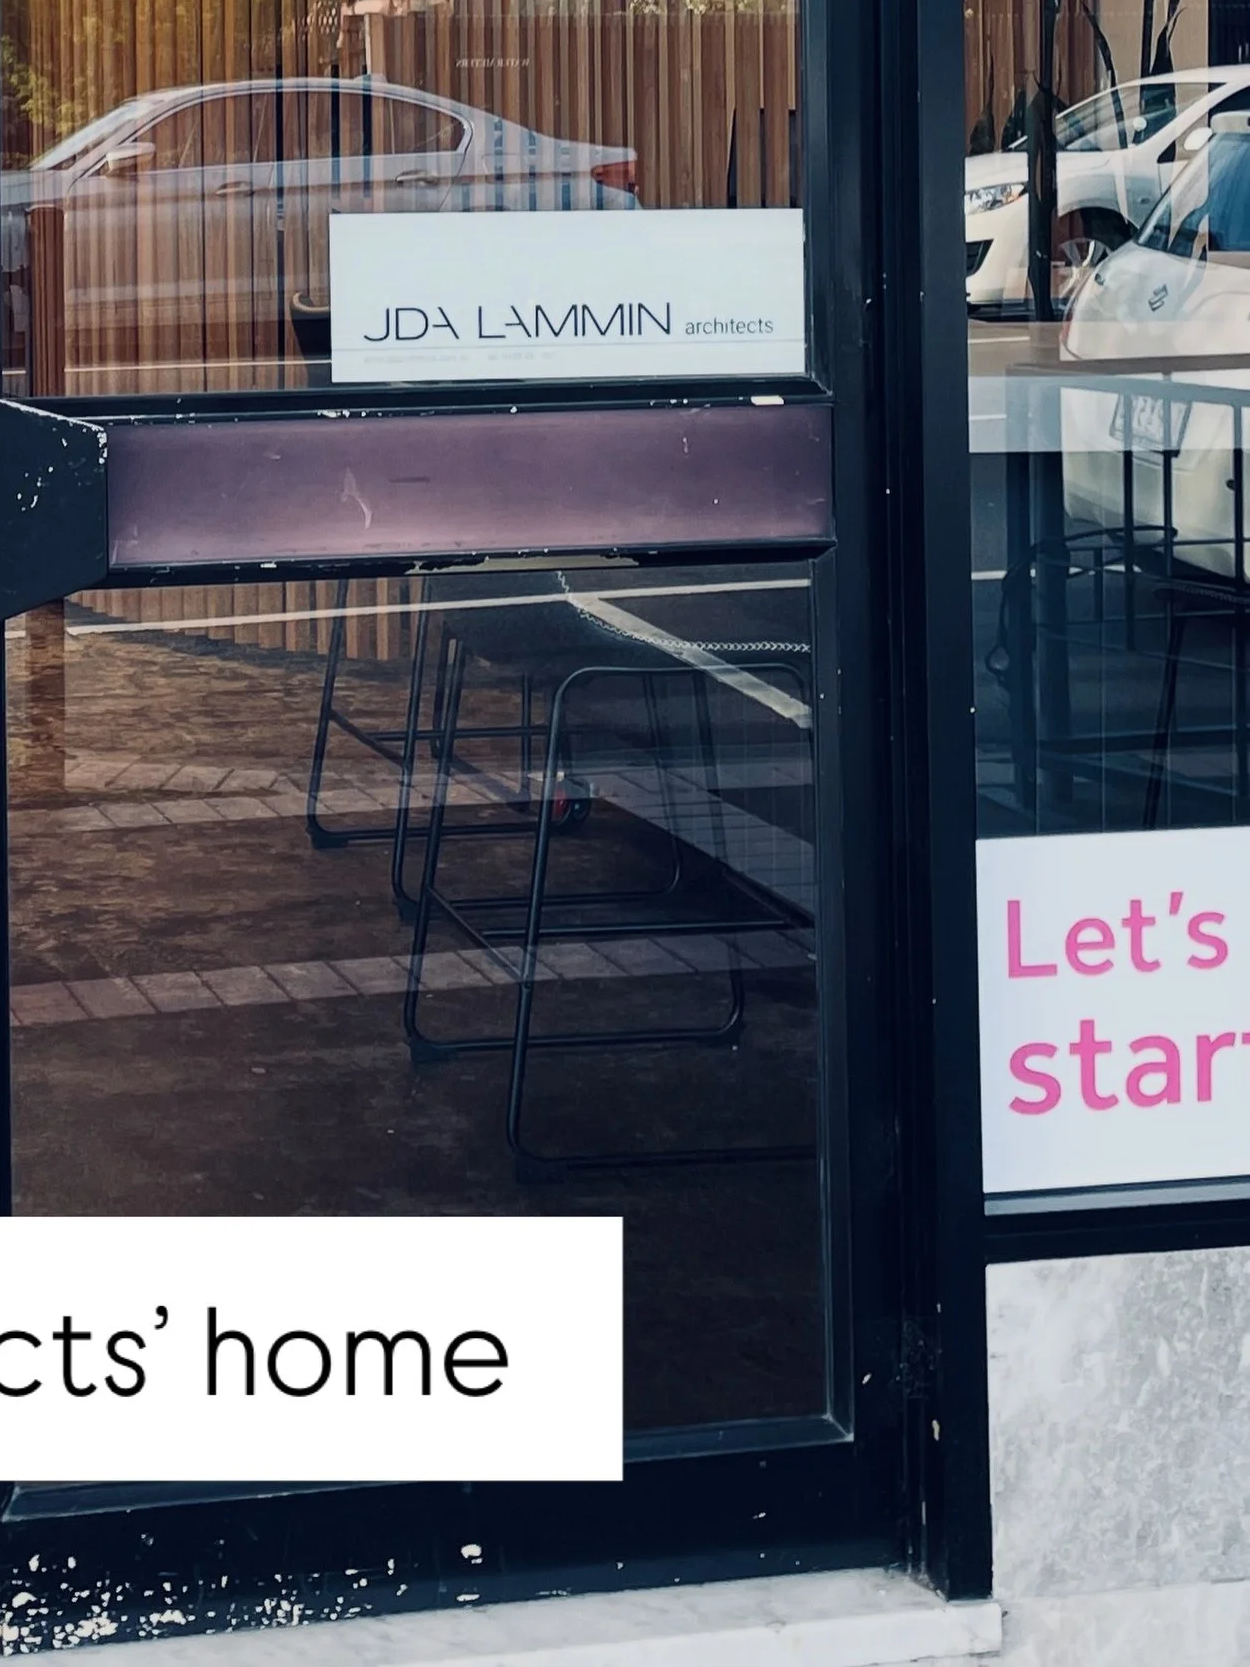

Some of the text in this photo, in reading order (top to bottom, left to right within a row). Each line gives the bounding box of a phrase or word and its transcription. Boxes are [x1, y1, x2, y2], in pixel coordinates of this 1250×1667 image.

[363, 302, 774, 342] JDA LAMMIN architects
[1008, 892, 1228, 978] Let’s
[1010, 1019, 1250, 1114] star
